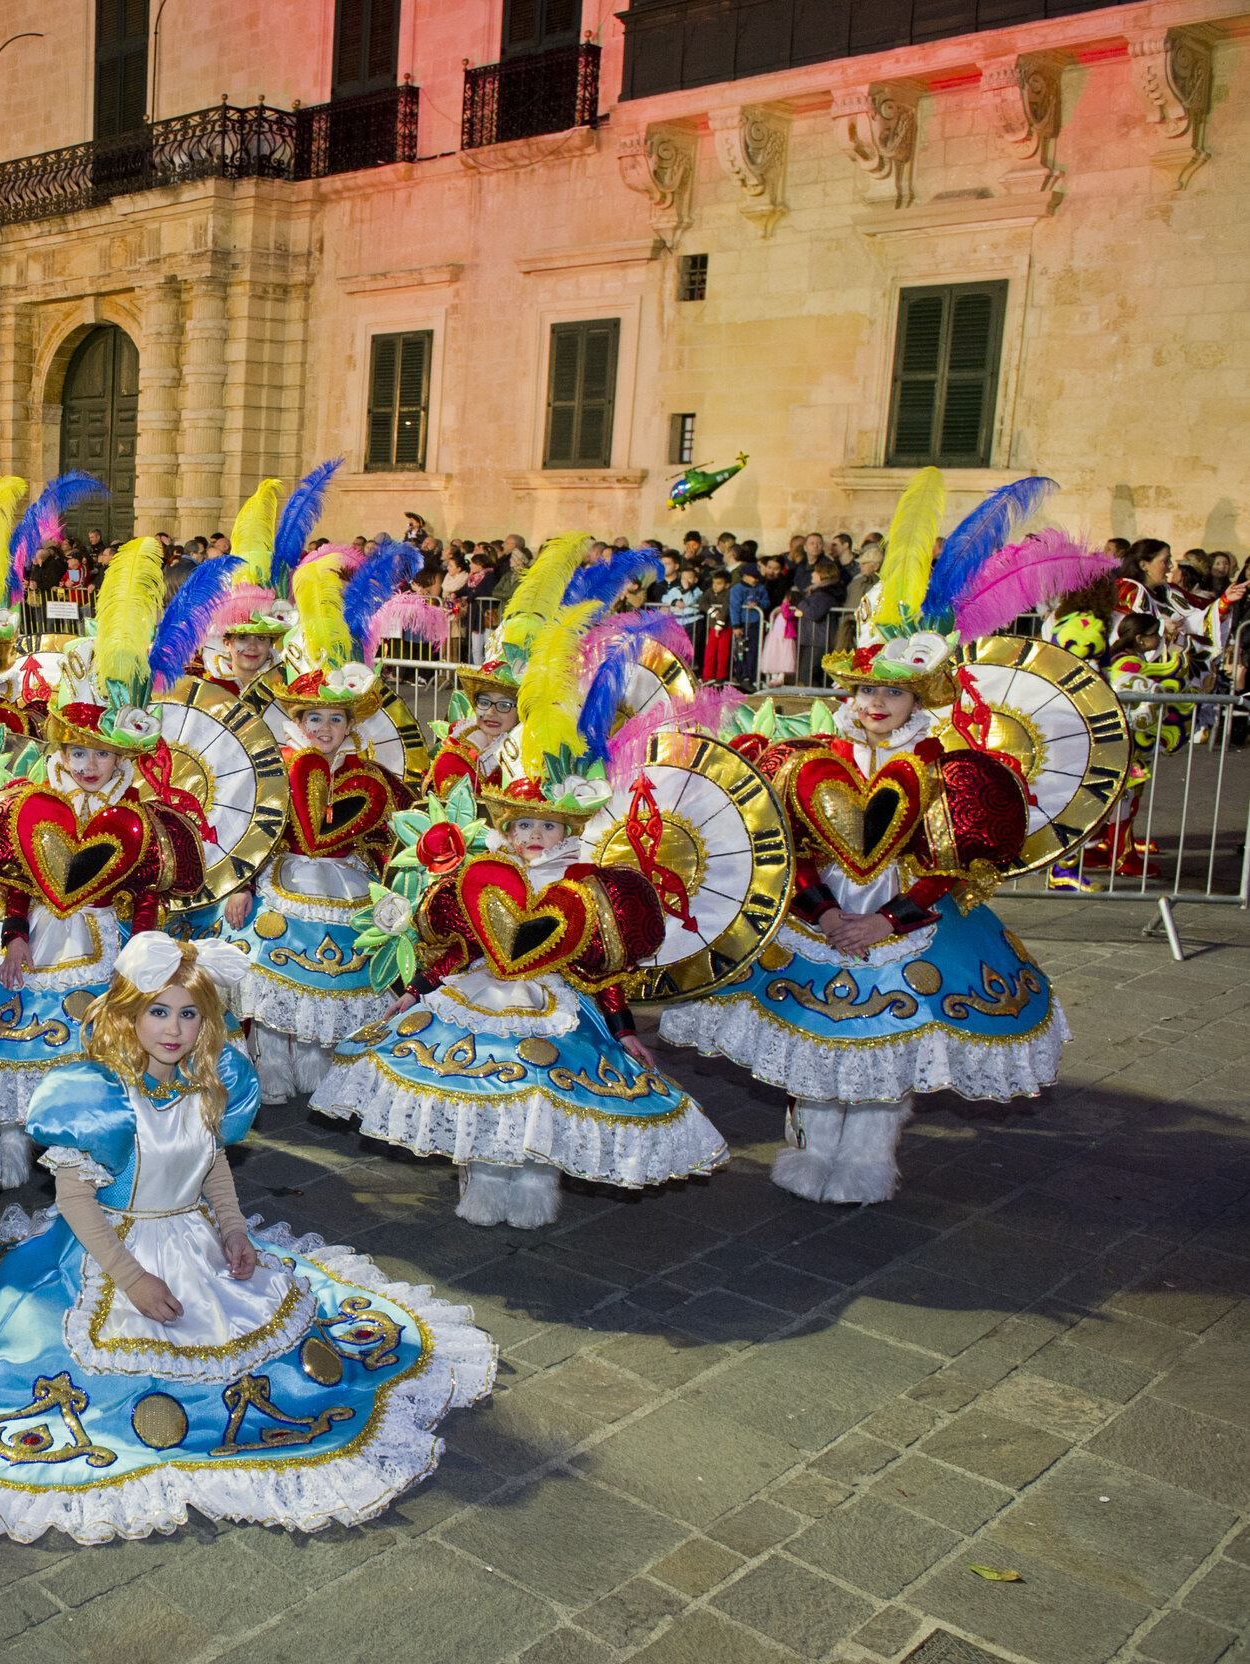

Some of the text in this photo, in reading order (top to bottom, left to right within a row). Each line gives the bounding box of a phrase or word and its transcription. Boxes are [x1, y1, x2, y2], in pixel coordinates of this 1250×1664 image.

[1087, 710, 1125, 744] III
[251, 747, 286, 779] III
[752, 827, 787, 867] III
